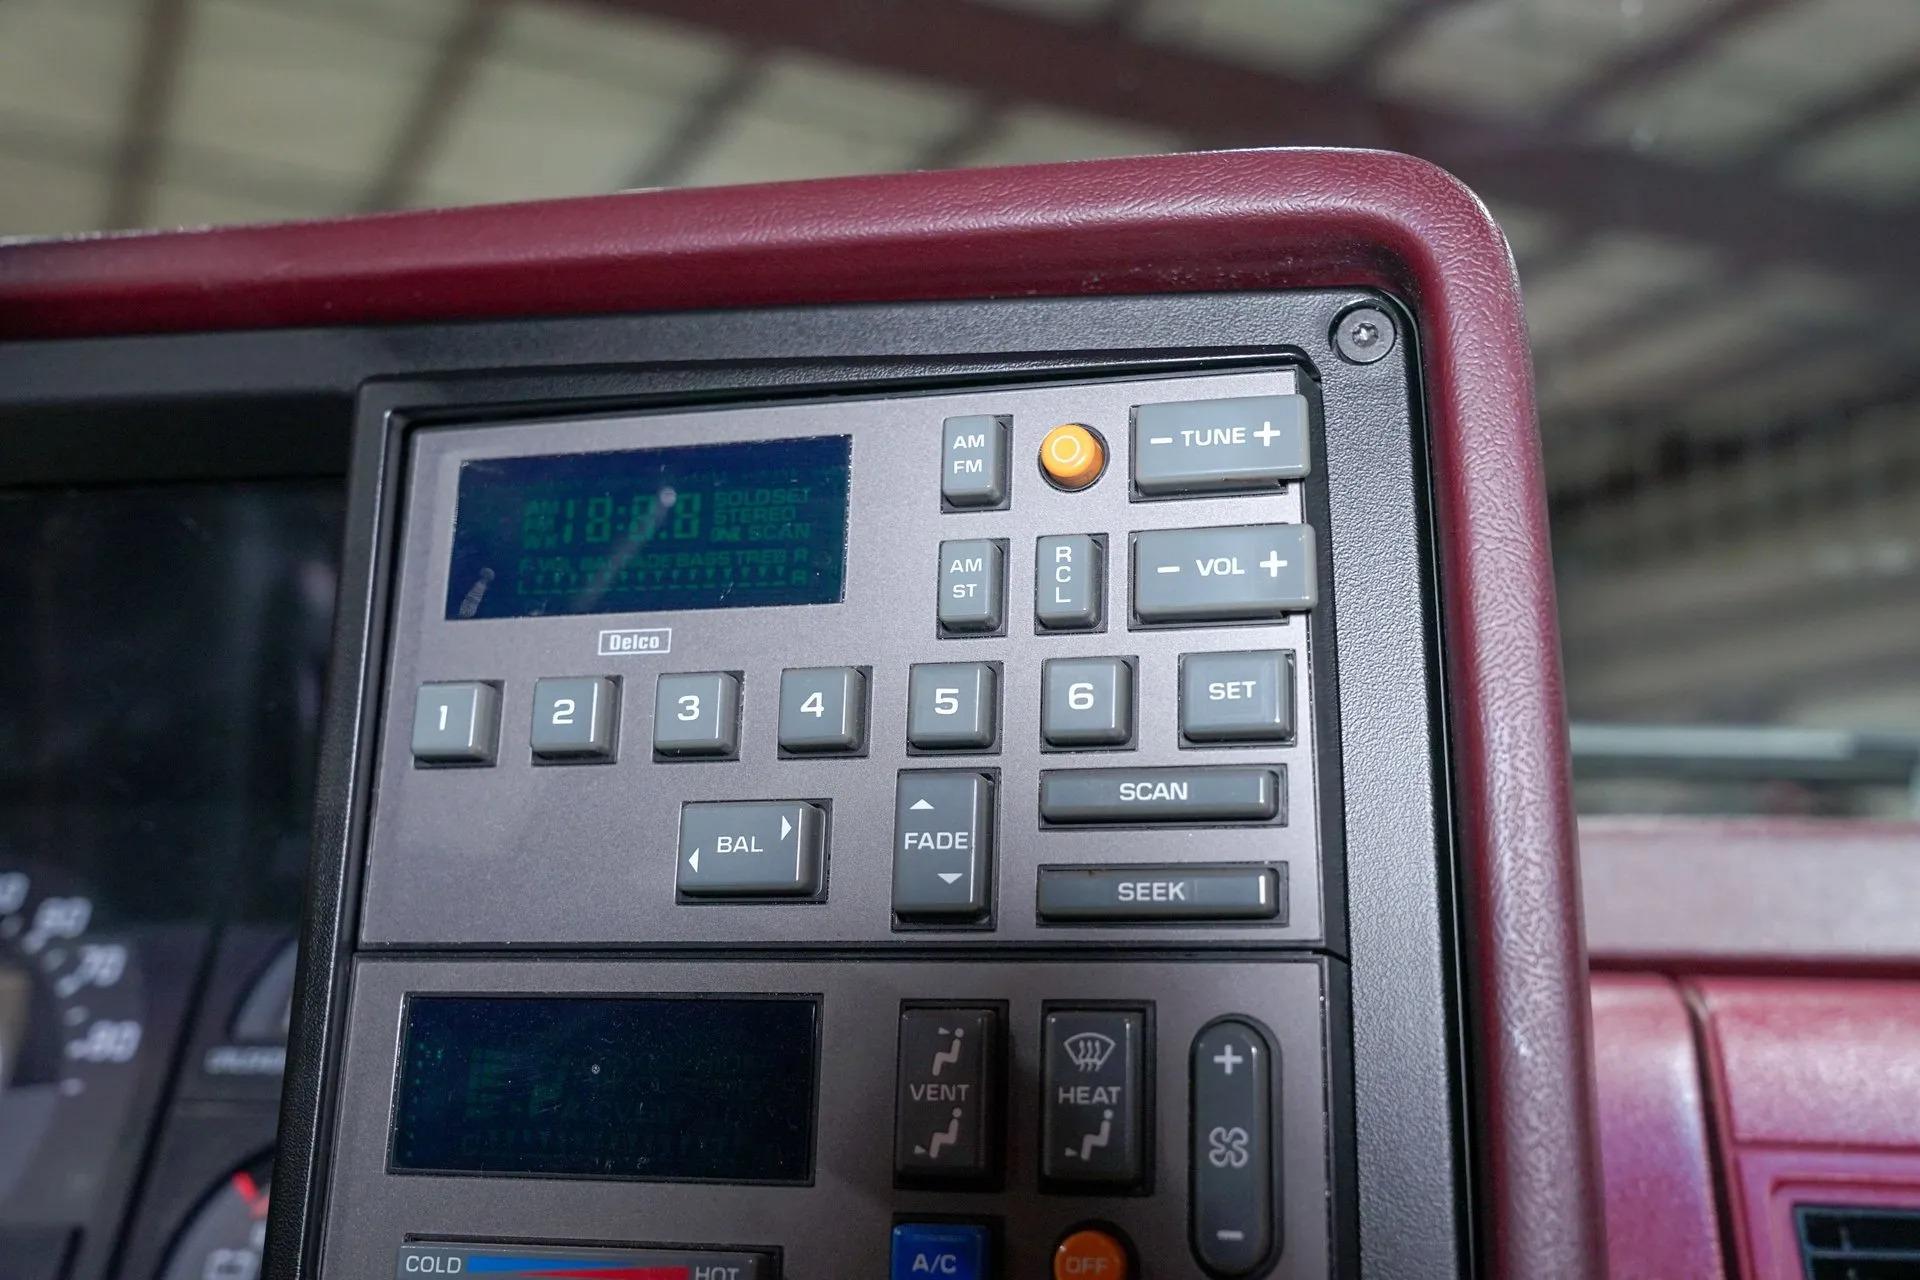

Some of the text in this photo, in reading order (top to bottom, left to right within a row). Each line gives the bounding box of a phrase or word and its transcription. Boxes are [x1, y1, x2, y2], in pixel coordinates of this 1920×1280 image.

[952, 433, 985, 449] AM
[1181, 427, 1246, 447] TUNE
[953, 459, 983, 473] FM
[950, 558, 982, 573] AM
[1055, 546, 1071, 603] RCL
[1196, 557, 1245, 576] VOL
[953, 584, 977, 598] ST
[609, 634, 660, 650] Delco
[1068, 683, 1095, 710] 6
[1209, 681, 1256, 700] SET
[677, 695, 700, 721] 3
[800, 692, 824, 717] 4
[934, 688, 960, 715] 5
[438, 705, 448, 731] 1
[552, 699, 575, 724] 2
[1119, 782, 1188, 801] SCAN
[716, 836, 763, 853] BAL
[904, 832, 968, 850] FADE
[1118, 881, 1185, 901] SEEK
[910, 1083, 970, 1101] VENT
[1058, 1086, 1121, 1105] HEAT
[405, 1255, 461, 1274] COLD
[912, 1253, 957, 1274] A/C
[1064, 1256, 1108, 1275] OFF
